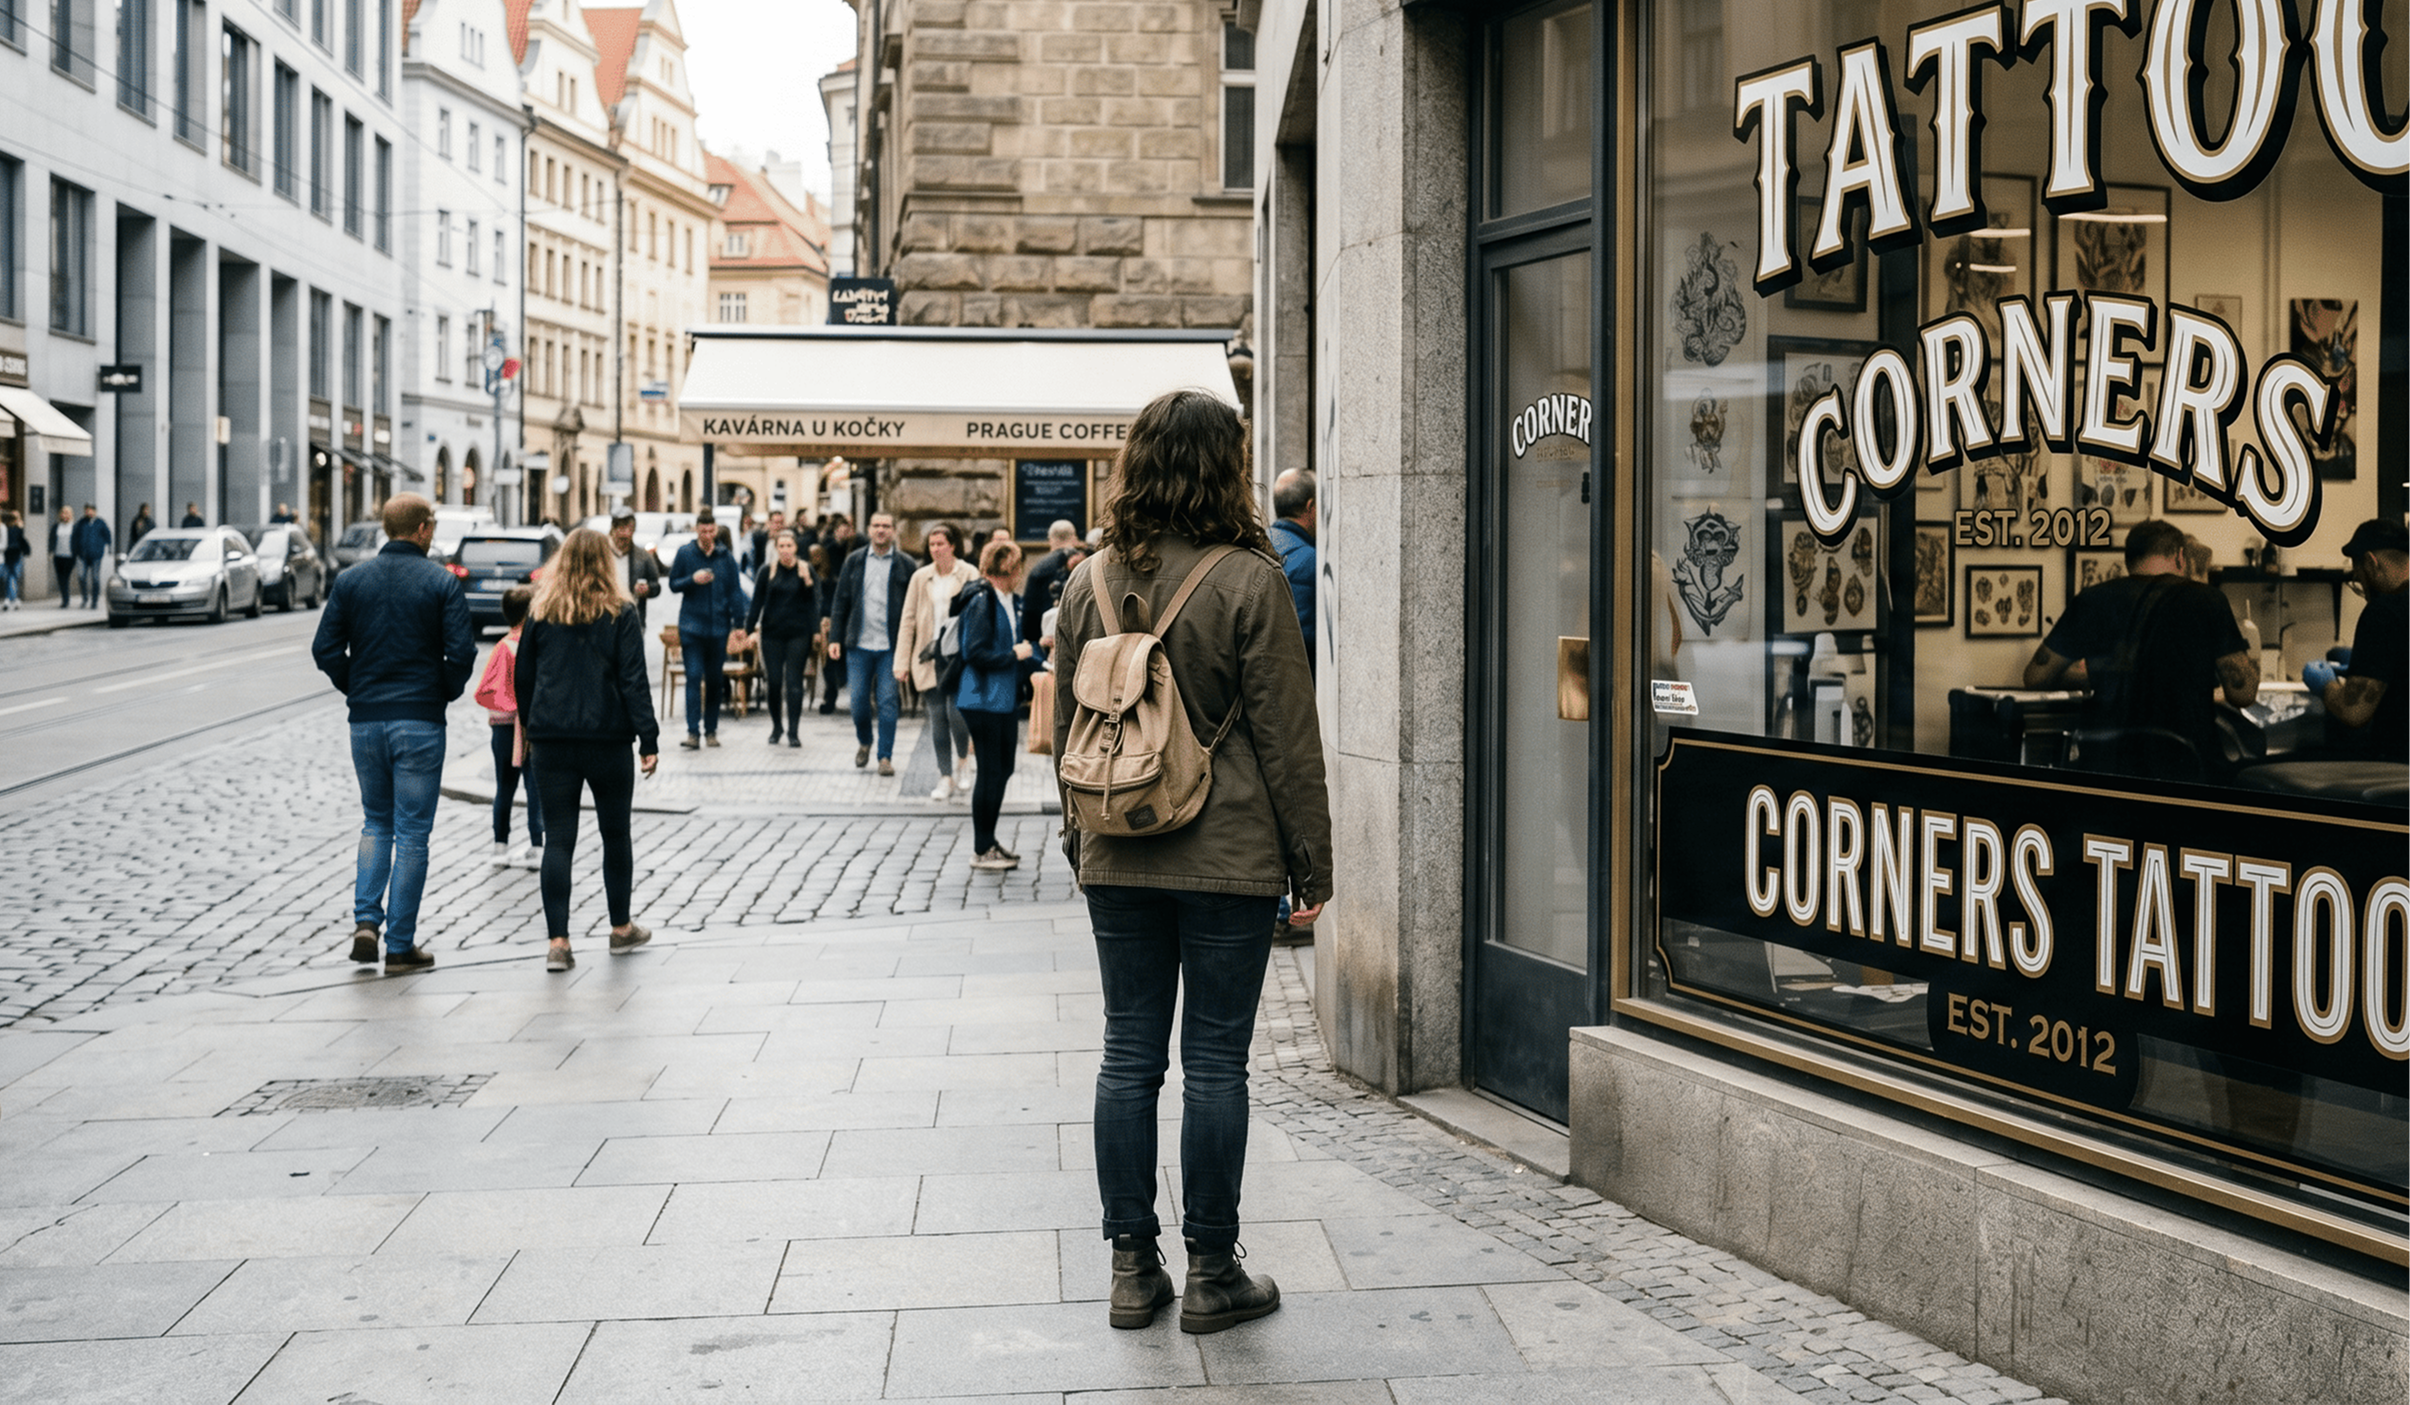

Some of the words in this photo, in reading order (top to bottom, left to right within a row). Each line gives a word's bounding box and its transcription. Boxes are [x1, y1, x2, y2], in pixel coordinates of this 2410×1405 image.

[703, 414, 805, 436] KAVÁRNA
[812, 420, 826, 437] U
[833, 416, 905, 438] KOČKY
[966, 422, 1053, 439] PRAGUE
[1059, 423, 1134, 440] COFFE
[1512, 393, 1592, 458] CORNER
[1798, 294, 2333, 539] CORNERS
[1954, 509, 2022, 546] EST.
[2030, 508, 2111, 547] 2012
[1745, 784, 2055, 979] CORNERS
[2083, 833, 2410, 1061] TATTOO
[1947, 992, 2018, 1049] EST.
[2028, 1014, 2117, 1077] 2012
